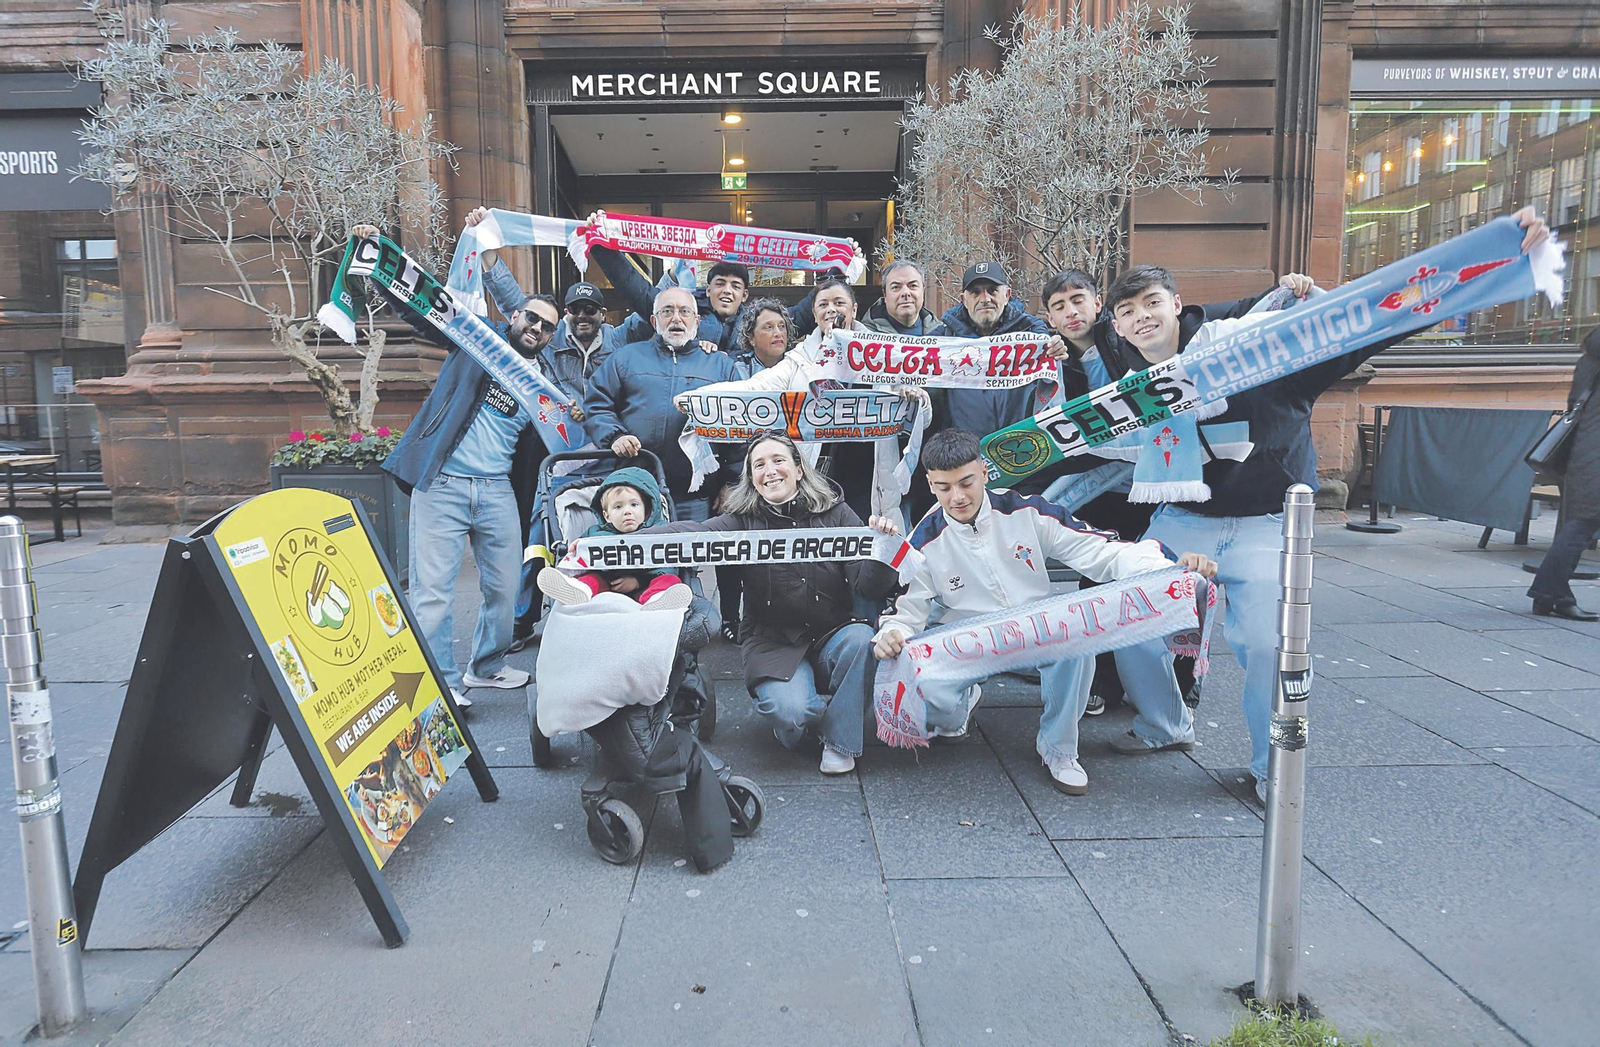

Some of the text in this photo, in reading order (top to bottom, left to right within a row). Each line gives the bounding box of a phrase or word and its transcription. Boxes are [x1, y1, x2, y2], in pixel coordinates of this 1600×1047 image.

[571, 70, 881, 96] MERCHANT SQUARE
[1383, 65, 1600, 81] PURVEYORS OF WHISKEY, STOUT & CRA
[0, 150, 58, 175] SPORTS
[617, 241, 650, 251] СТАДИОН
[621, 221, 697, 246] ЦРВЕНА ЗВЕЗДА
[733, 234, 799, 257] RC CELTA
[701, 247, 727, 256] EUROPA
[737, 254, 794, 267] 29.01.2026
[355, 238, 453, 314] CELTS
[458, 315, 510, 364] CELTA
[502, 355, 545, 395] VIGO
[378, 271, 428, 309] THURSDAY
[449, 327, 490, 365] OCTOBER
[490, 364, 513, 387] 2026
[988, 335, 1013, 343] VIVA
[985, 343, 1057, 377] RRA
[1046, 376, 1183, 444] CELTS
[1199, 331, 1291, 388] CELTA
[1289, 298, 1372, 353] VIGO
[1115, 326, 1262, 393] EUROPE 2026/27
[900, 376, 927, 385] SOMOS
[1089, 409, 1166, 443] THURSDAY
[1206, 365, 1286, 401] OCTOBER
[1290, 343, 1342, 370] 2026
[804, 395, 915, 426] CELTA
[695, 425, 727, 438] MOS
[815, 426, 862, 438] DUNHA
[276, 534, 337, 578] MOMO
[650, 540, 750, 564] CELTISTA
[757, 538, 789, 560] DE
[792, 535, 874, 559] ARCADE
[942, 585, 1162, 662] CELTA
[334, 634, 361, 658] HUB
[313, 641, 407, 719] MOMO HUB MOTHER NEPAL
[335, 690, 399, 753] WE ARE INSIDE
